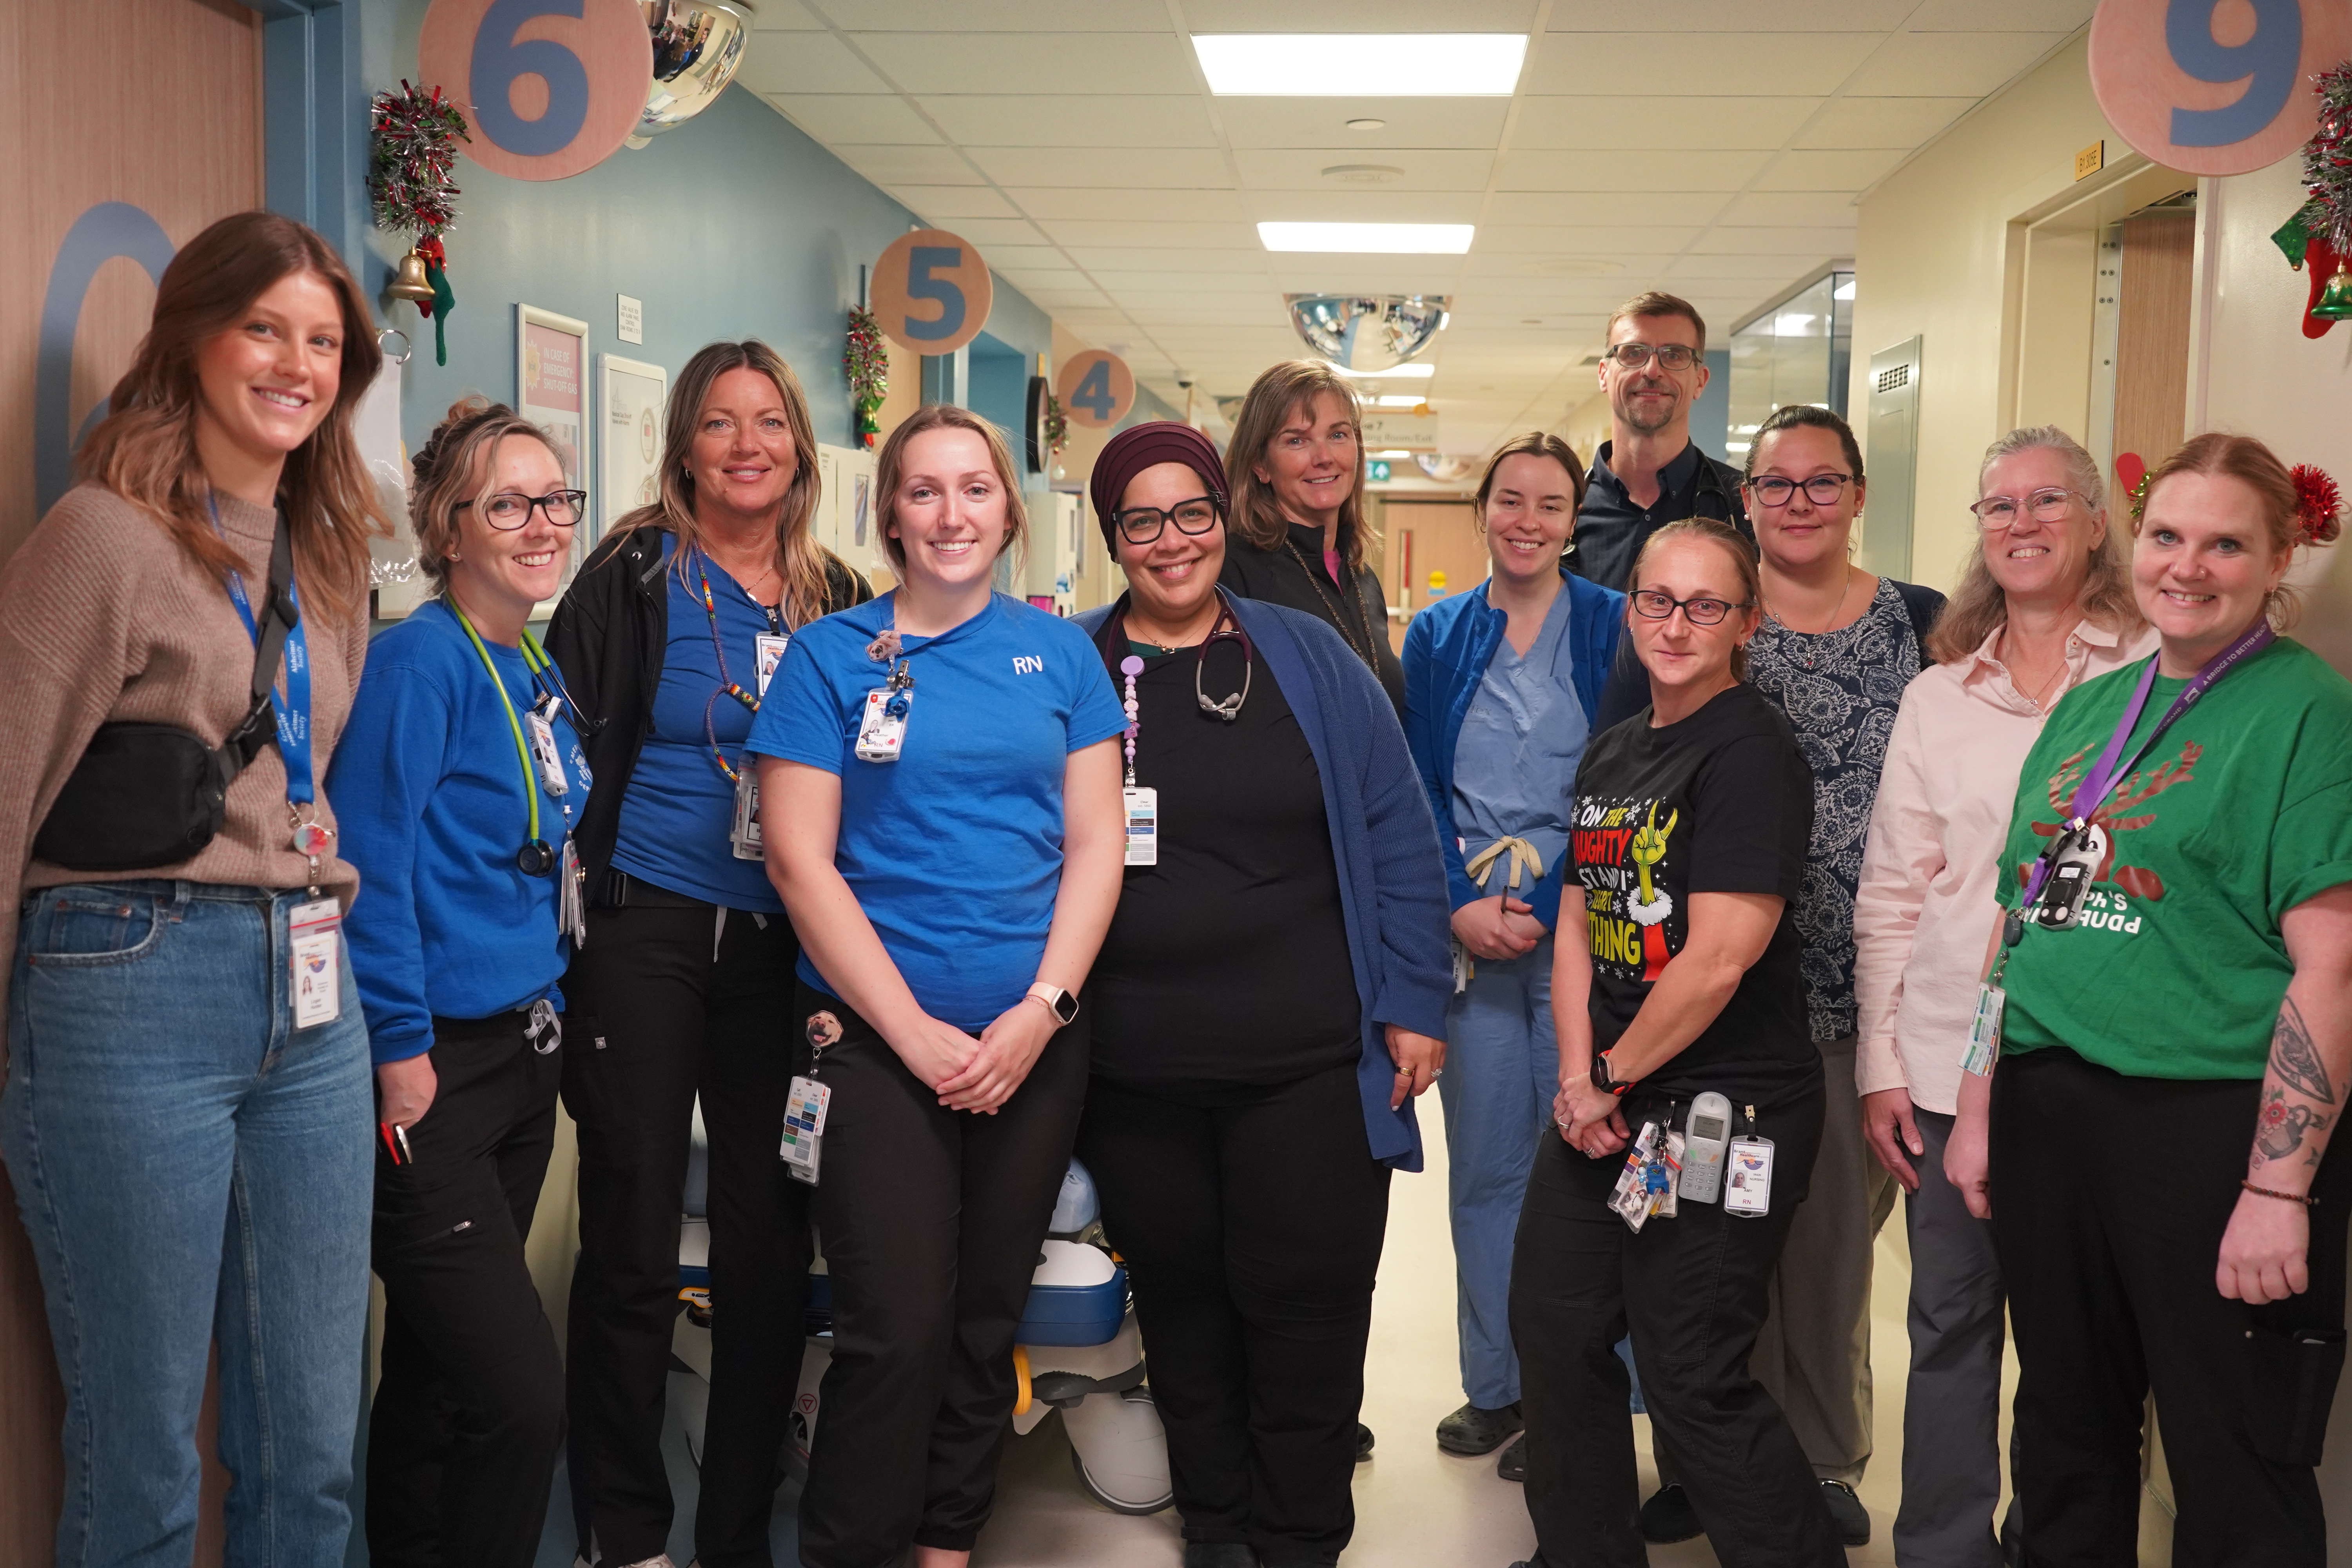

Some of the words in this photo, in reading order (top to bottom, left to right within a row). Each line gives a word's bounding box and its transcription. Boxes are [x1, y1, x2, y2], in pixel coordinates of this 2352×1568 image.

[470, 0, 588, 156] 6
[2166, 0, 2302, 147] 9
[905, 247, 966, 341] 5
[544, 347, 549, 359] IN
[550, 348, 562, 362] CASE
[563, 352, 570, 363] OF
[544, 362, 573, 379] EMERGENCY:
[544, 378, 567, 392] SHUT-OFF
[568, 383, 577, 395] GAS
[1071, 361, 1115, 420] 4
[290, 640, 298, 673] Alzheimer
[1013, 655, 1043, 675] RN
[2207, 660, 2229, 681] BRIDGE
[2227, 653, 2237, 662] TO
[2235, 637, 2256, 655] BETTER
[2163, 706, 2182, 727] GRAND
[579, 780, 591, 792] DEP
[1581, 805, 1608, 827] ON
[1600, 807, 1629, 827] THE
[1597, 866, 1619, 889] AND
[1621, 869, 1626, 891] I
[1586, 909, 1641, 965] THING
